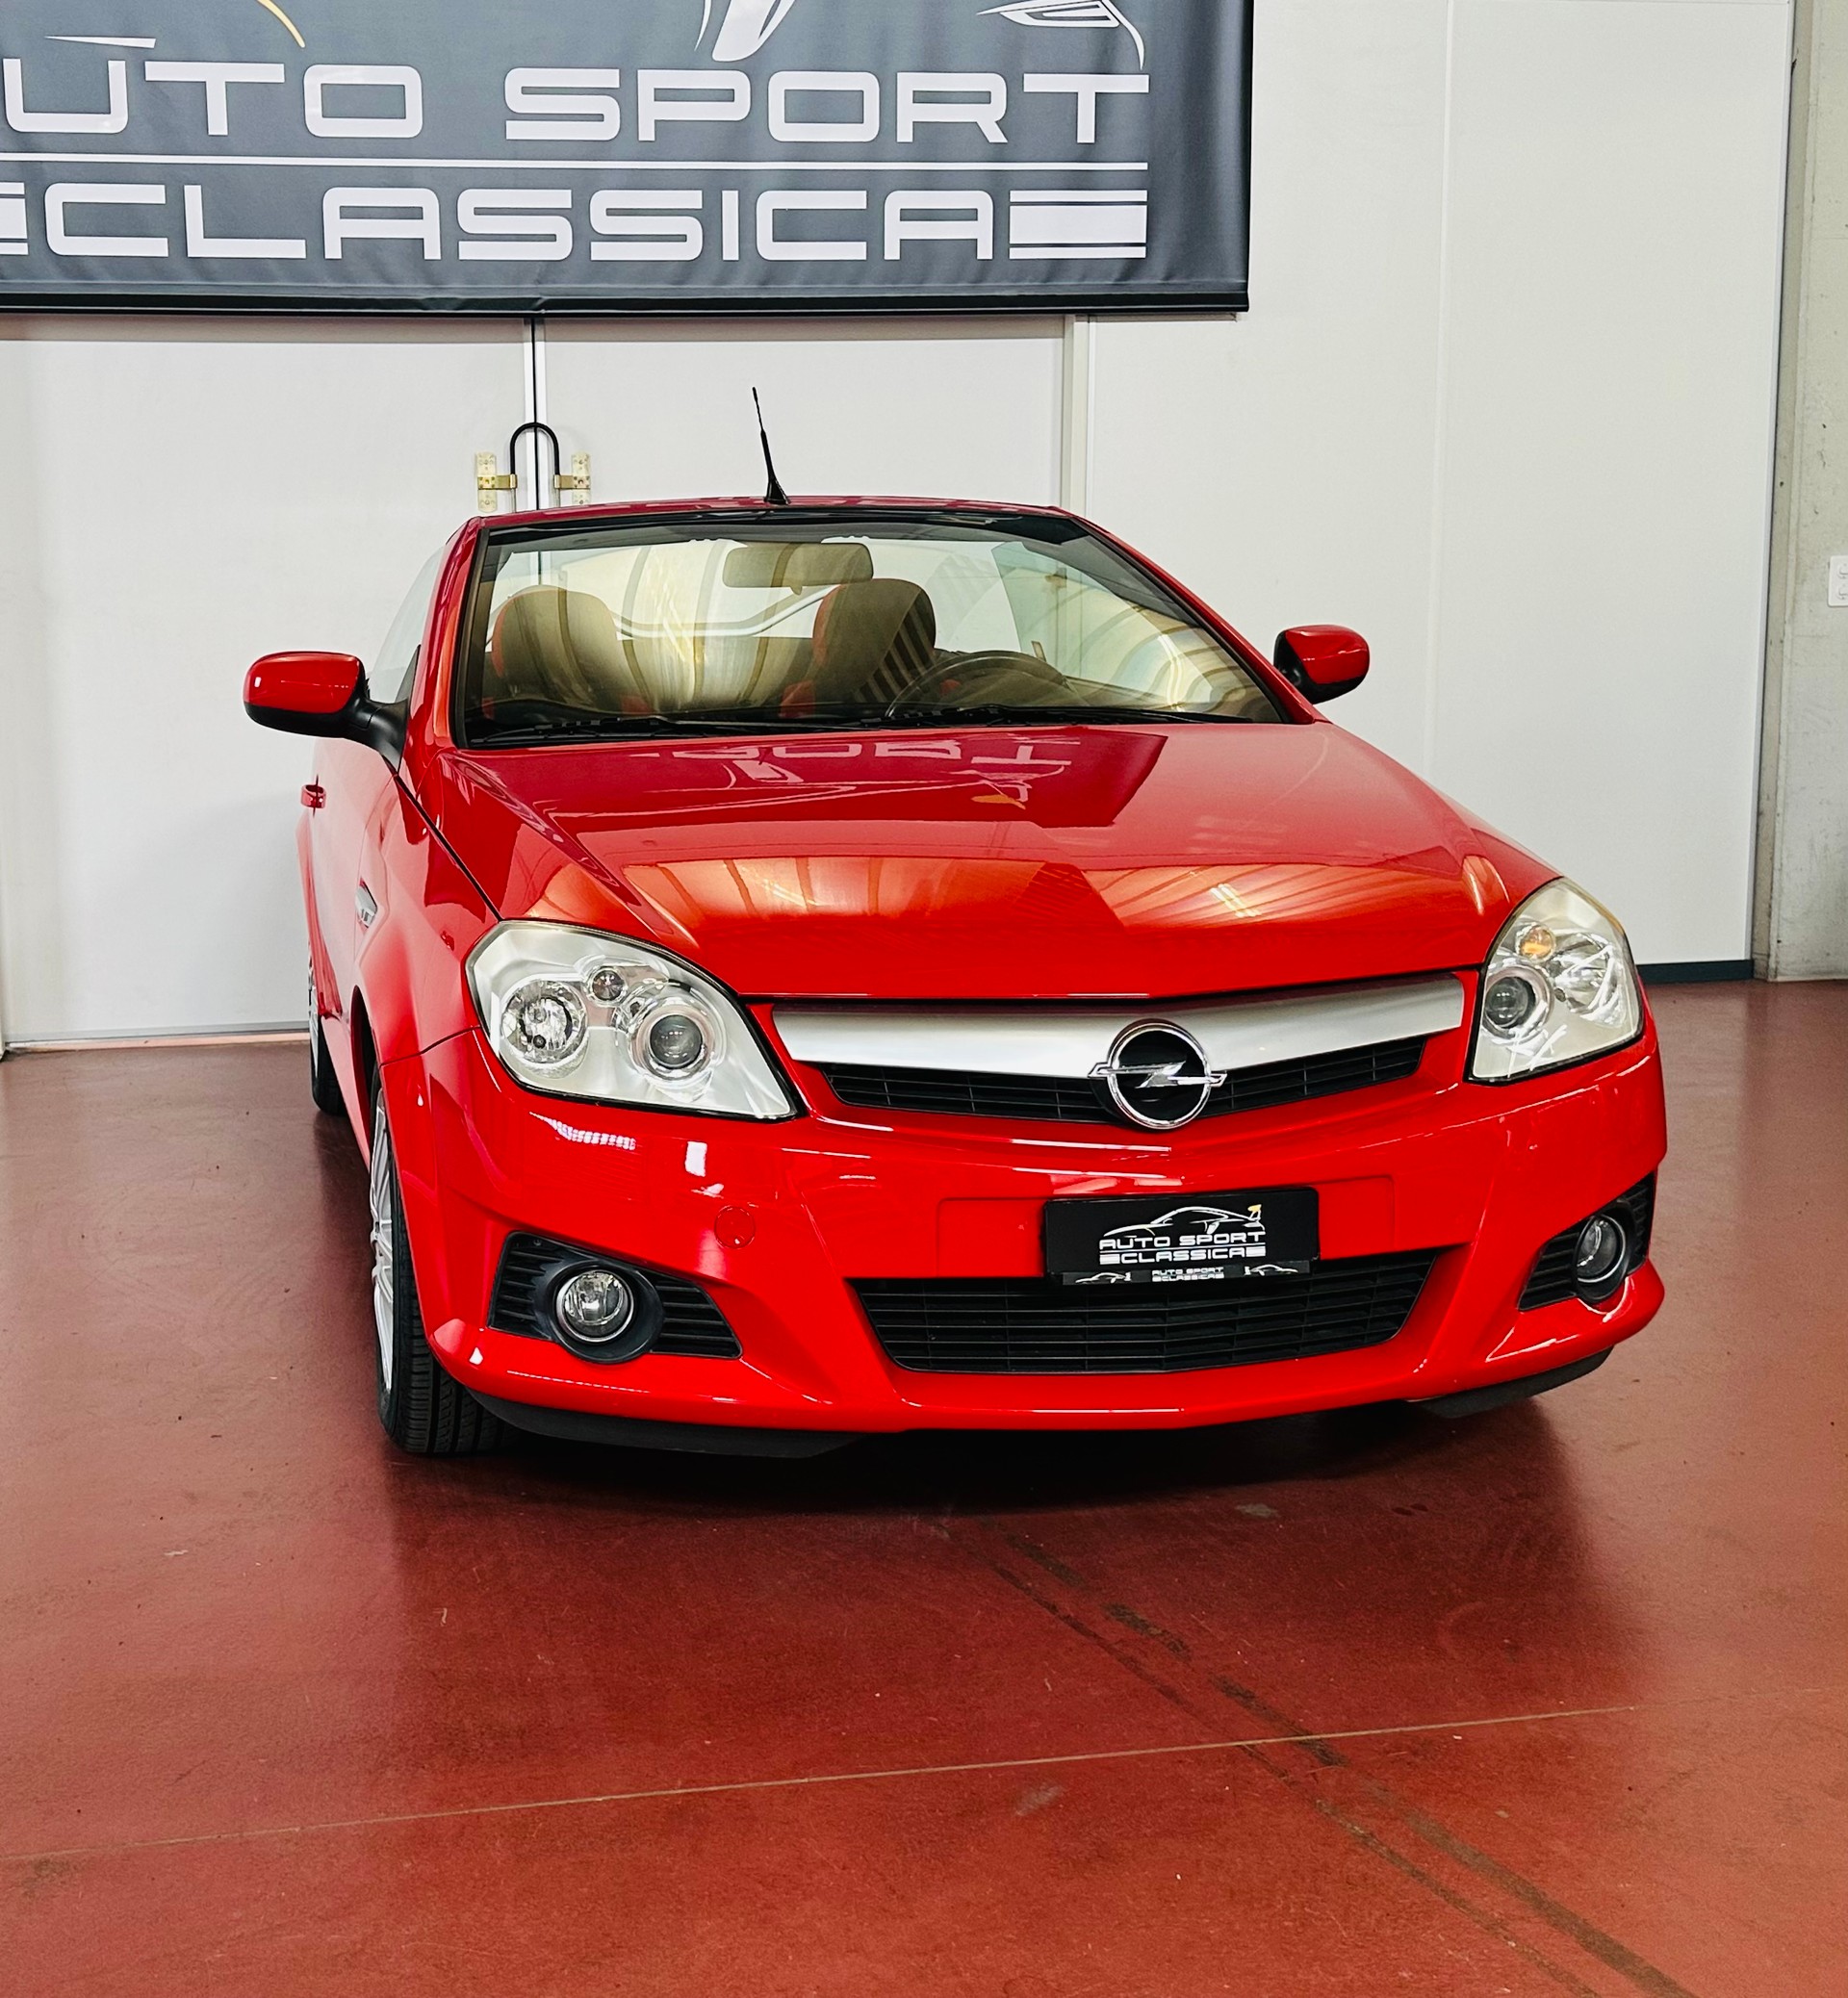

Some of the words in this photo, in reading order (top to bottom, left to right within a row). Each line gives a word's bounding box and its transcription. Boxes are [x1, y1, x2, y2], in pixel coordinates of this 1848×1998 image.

[504, 67, 1149, 143] SPORT
[44, 183, 993, 261] CLASSICA
[1099, 1236, 1171, 1250] AUTO
[1179, 1231, 1267, 1246] SPORT
[1120, 1247, 1245, 1264] CLASSICA
[1186, 1267, 1224, 1275] SPORT
